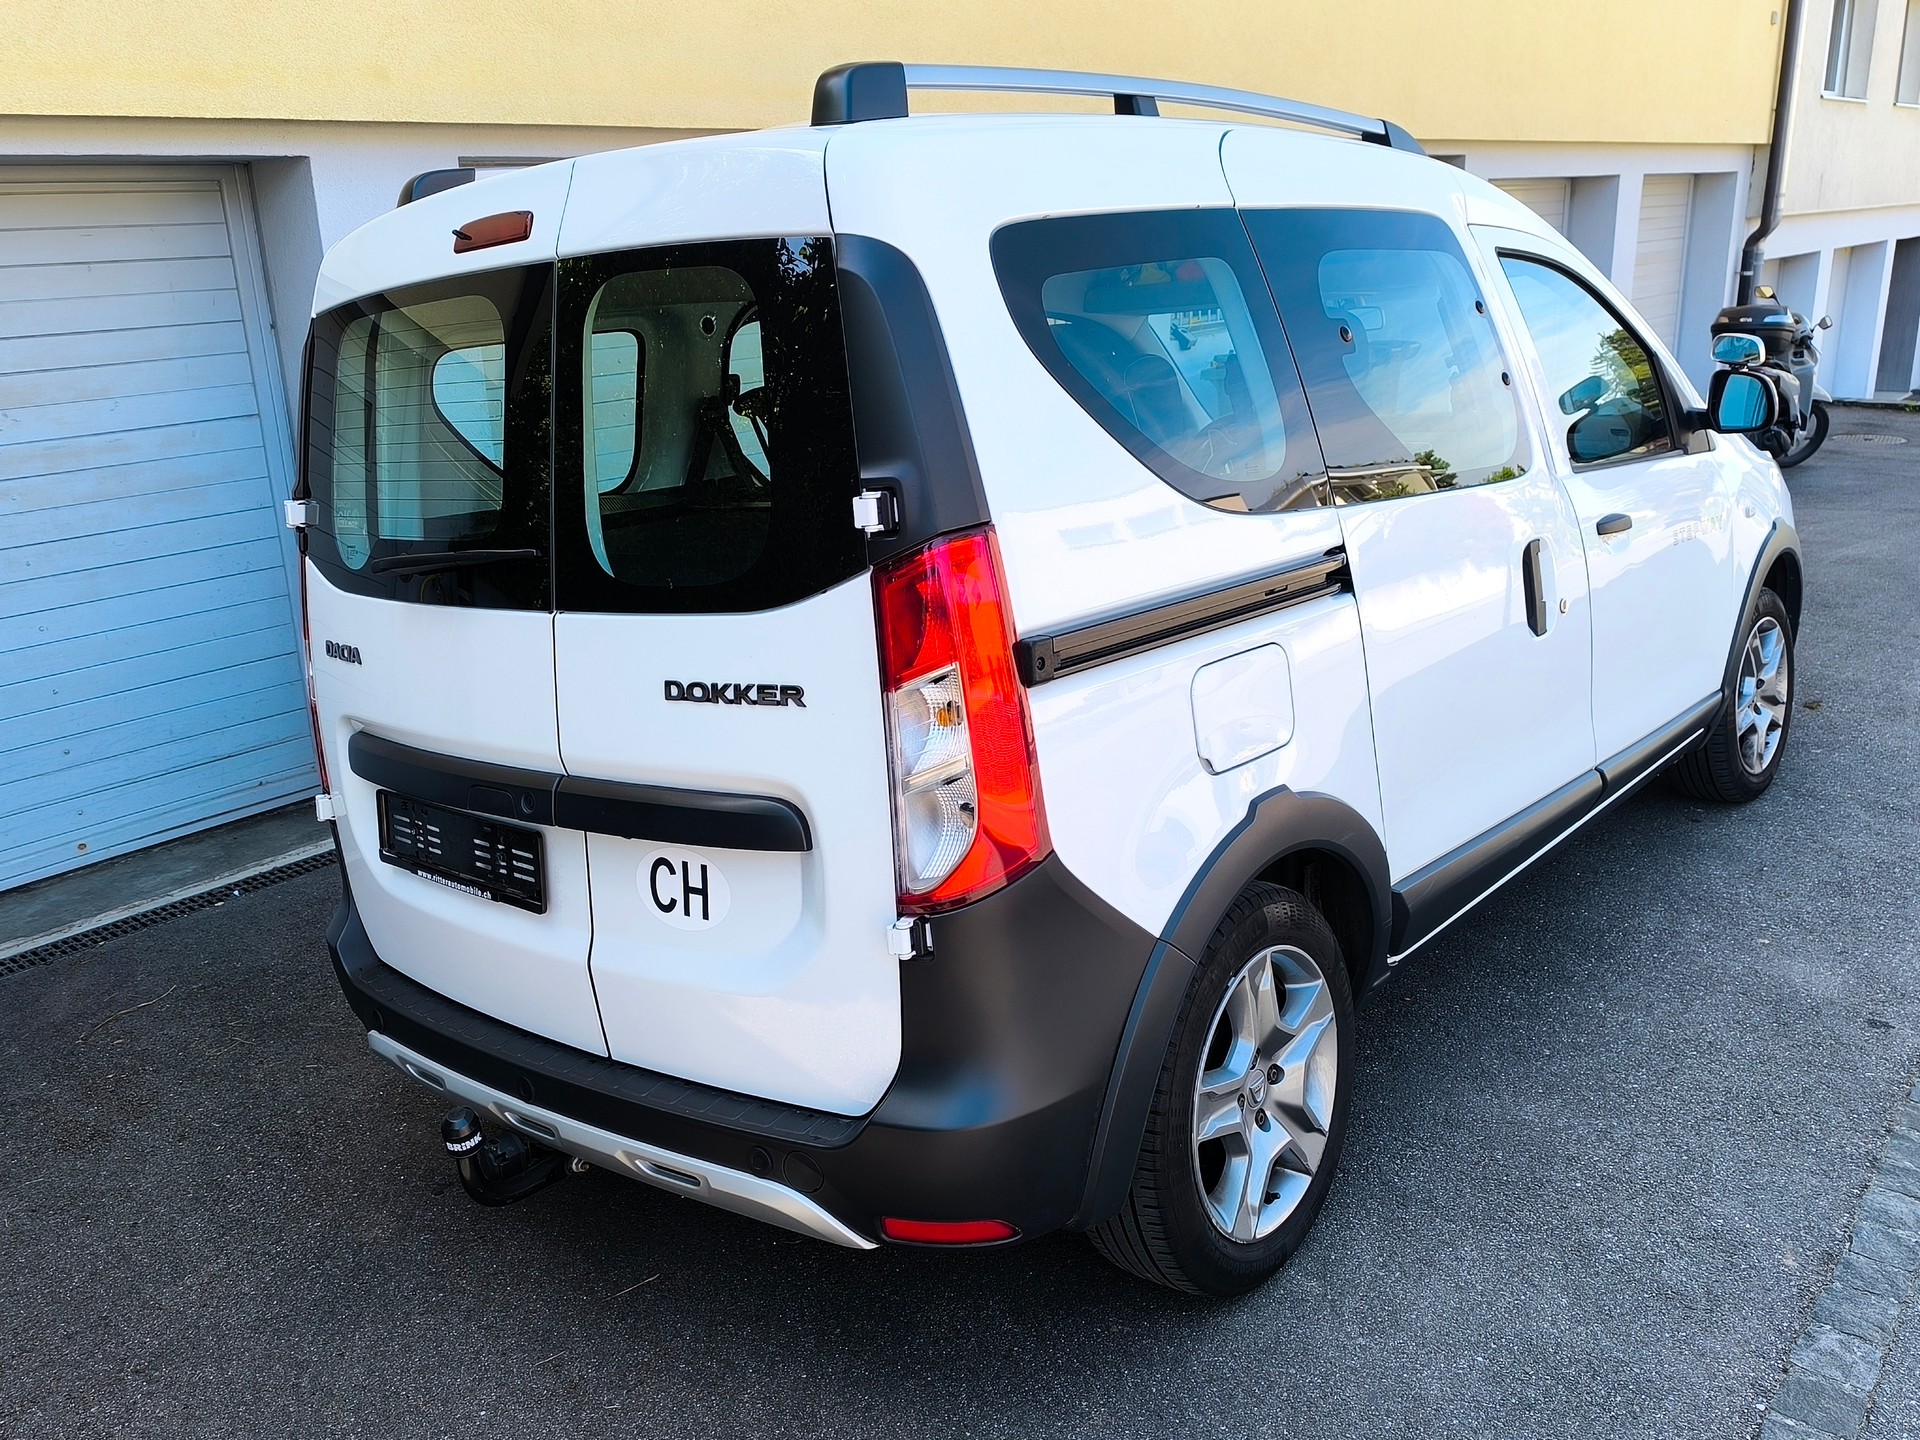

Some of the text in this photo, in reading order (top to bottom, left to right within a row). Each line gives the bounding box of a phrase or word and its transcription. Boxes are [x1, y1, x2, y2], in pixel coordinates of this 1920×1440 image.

[325, 640, 363, 666] DACIA
[664, 680, 808, 708] DOKKER
[417, 869, 492, 900] www.ritterautomobile.ch
[649, 856, 710, 921] CH
